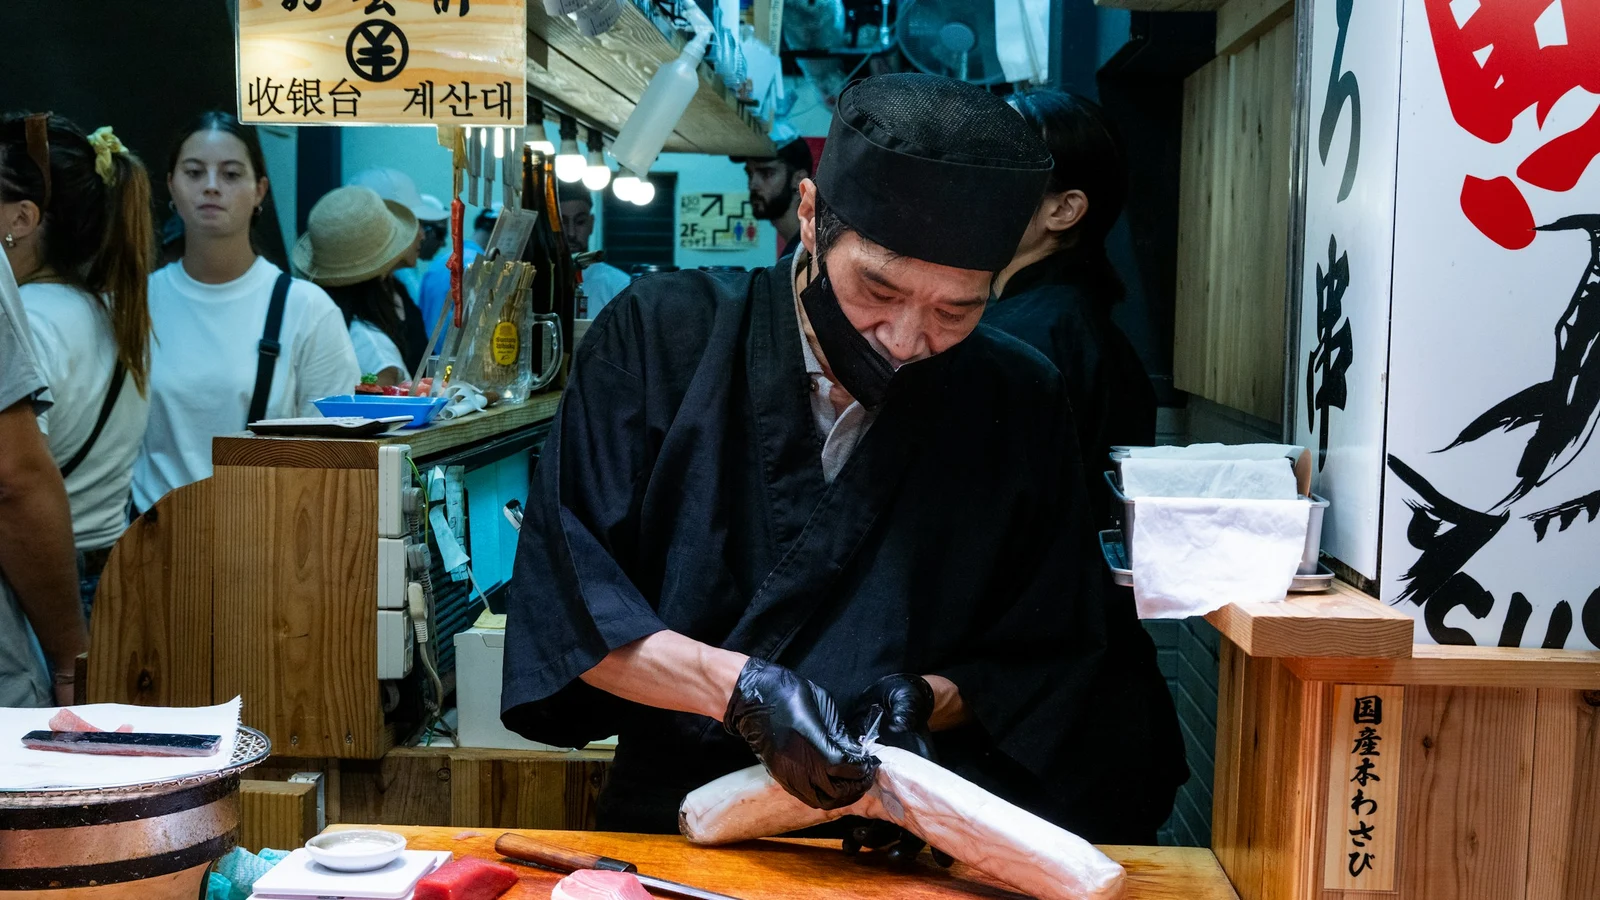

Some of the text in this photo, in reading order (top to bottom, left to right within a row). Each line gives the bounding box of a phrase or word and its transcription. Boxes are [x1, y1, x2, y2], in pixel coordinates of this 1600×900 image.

[248, 77, 362, 117] 收银台
[403, 80, 512, 119] 계산대
[1348, 695, 1383, 877] 国産本わさび
